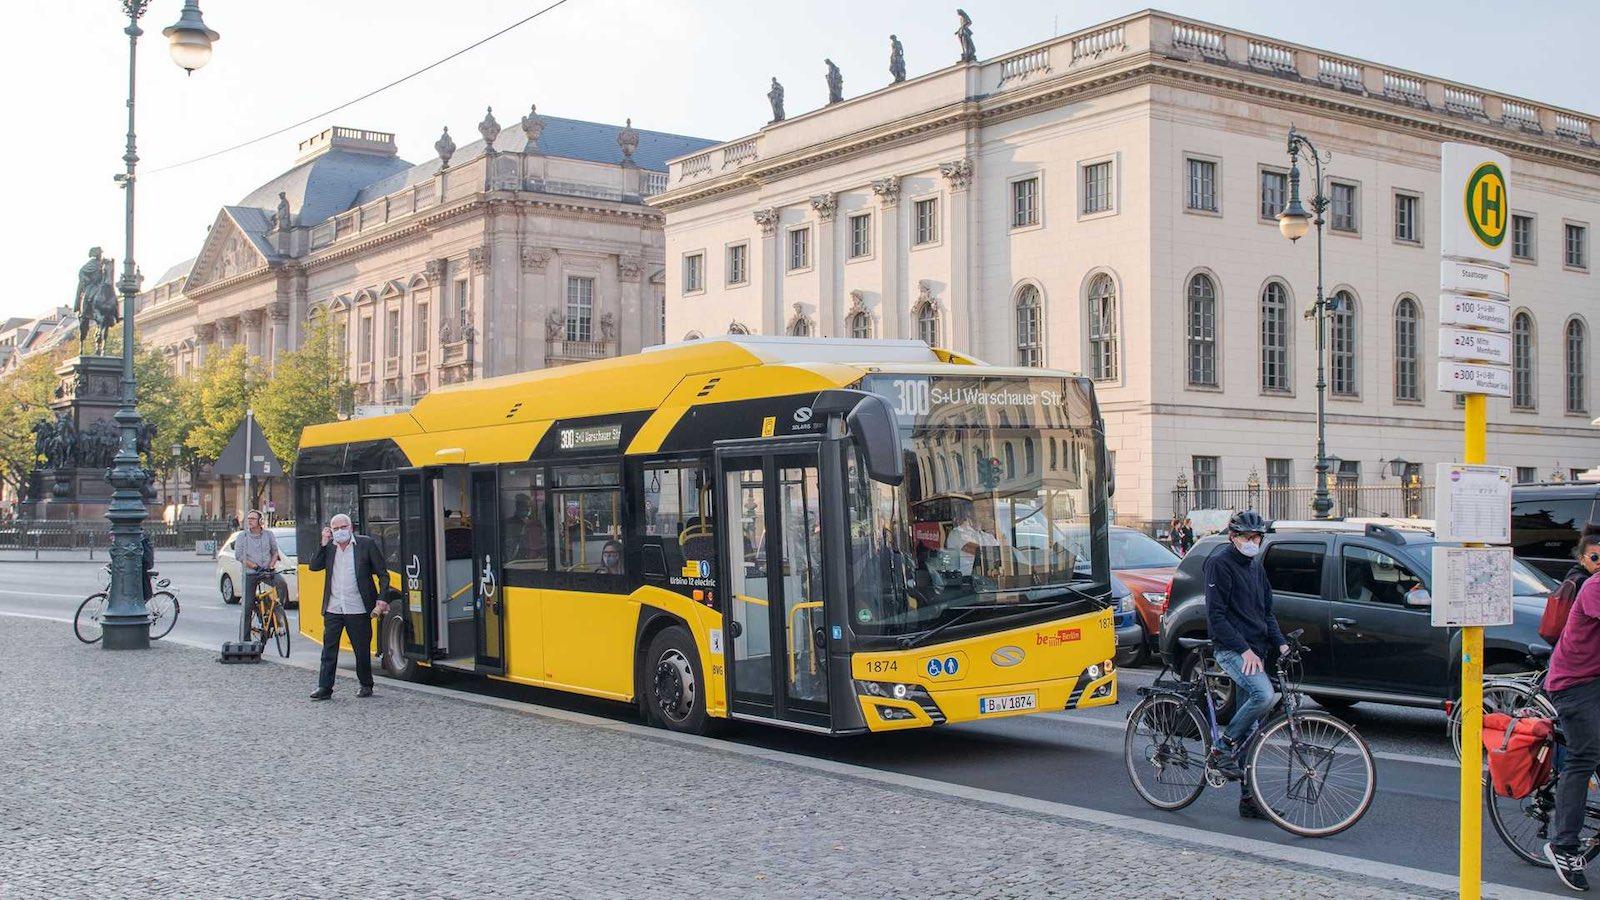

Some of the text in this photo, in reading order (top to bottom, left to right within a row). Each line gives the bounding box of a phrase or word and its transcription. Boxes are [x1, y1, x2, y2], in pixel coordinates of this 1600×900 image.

[1481, 181, 1501, 229] H
[1462, 302, 1474, 313] 100
[1460, 335, 1474, 346] 245
[1459, 369, 1474, 380] 300
[893, 379, 1064, 416] 300 S+U Warschauer Str.
[560, 429, 575, 449] 300
[670, 577, 688, 585] Urbino
[694, 579, 716, 587] electric
[1036, 630, 1080, 646] be Berlin
[866, 660, 897, 672] 1874
[988, 696, 1032, 711] B V 1874
